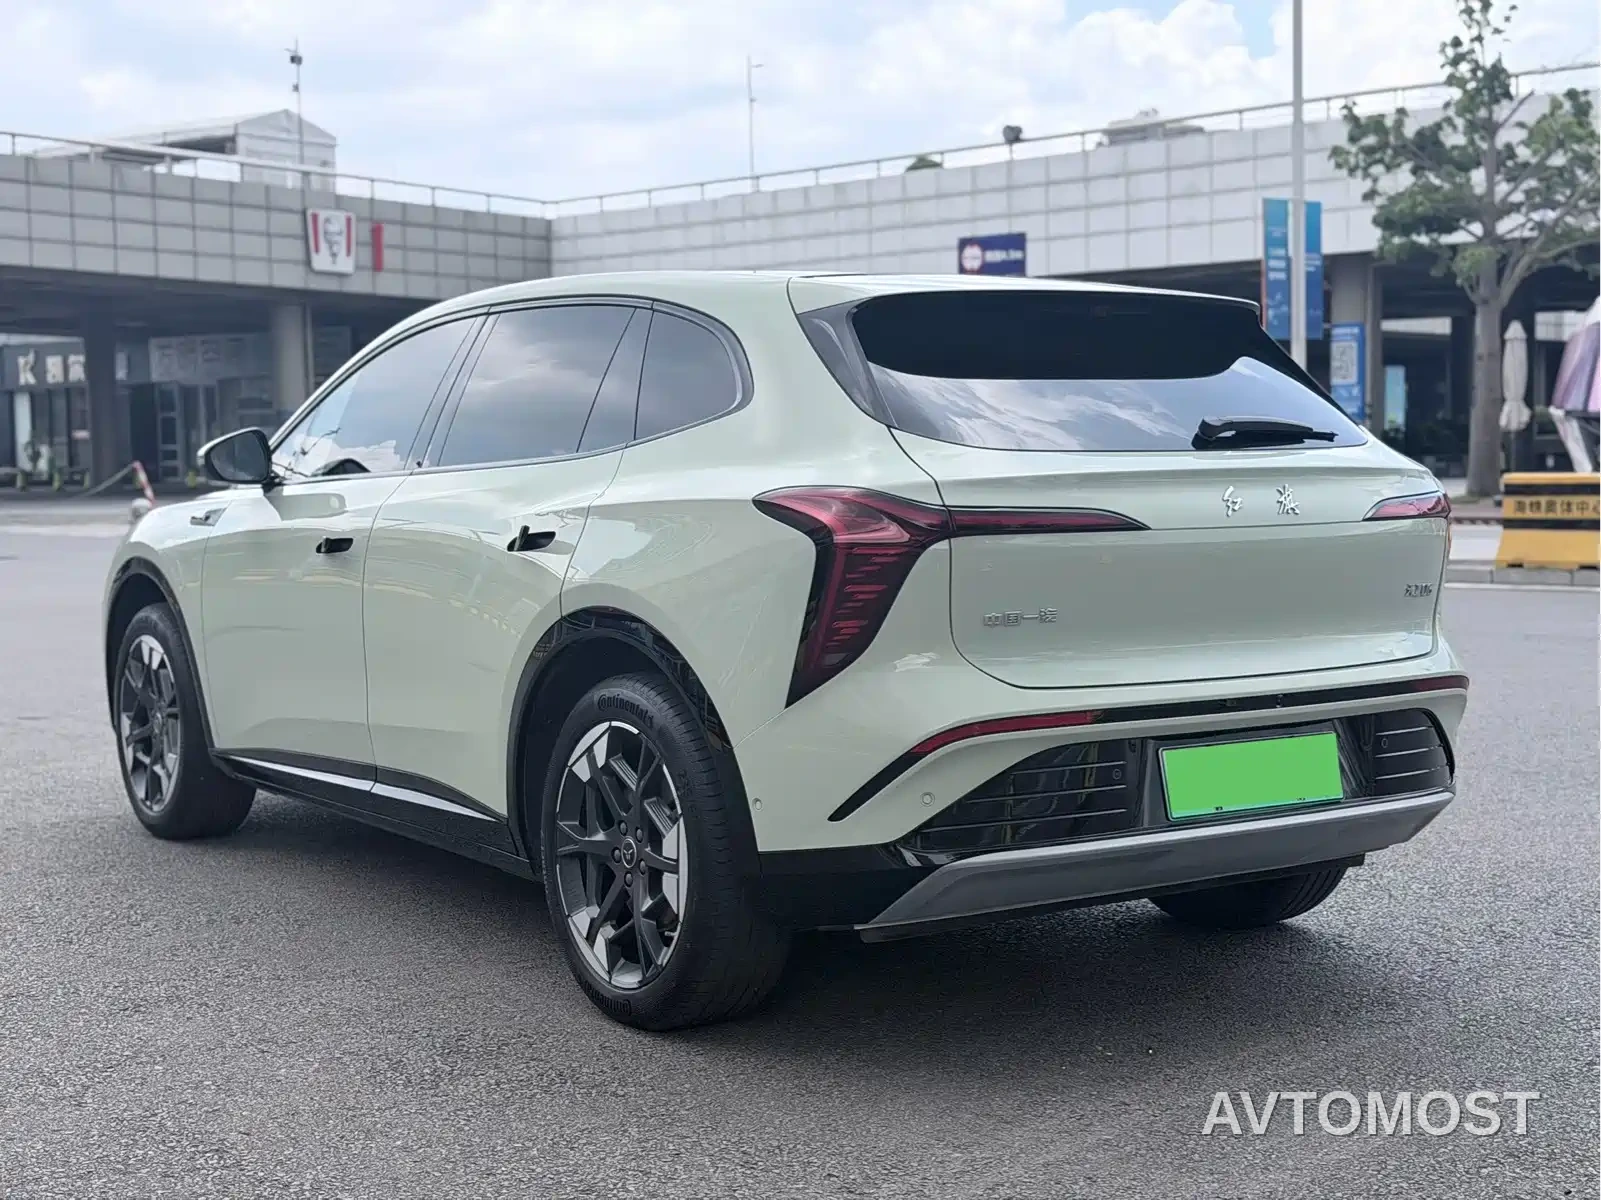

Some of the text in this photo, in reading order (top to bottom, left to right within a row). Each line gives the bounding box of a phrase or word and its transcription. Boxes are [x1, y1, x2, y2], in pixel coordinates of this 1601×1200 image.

[1222, 483, 1301, 517] 红旗
[983, 607, 1058, 629] 中国一汽
[597, 693, 650, 725] Continental
